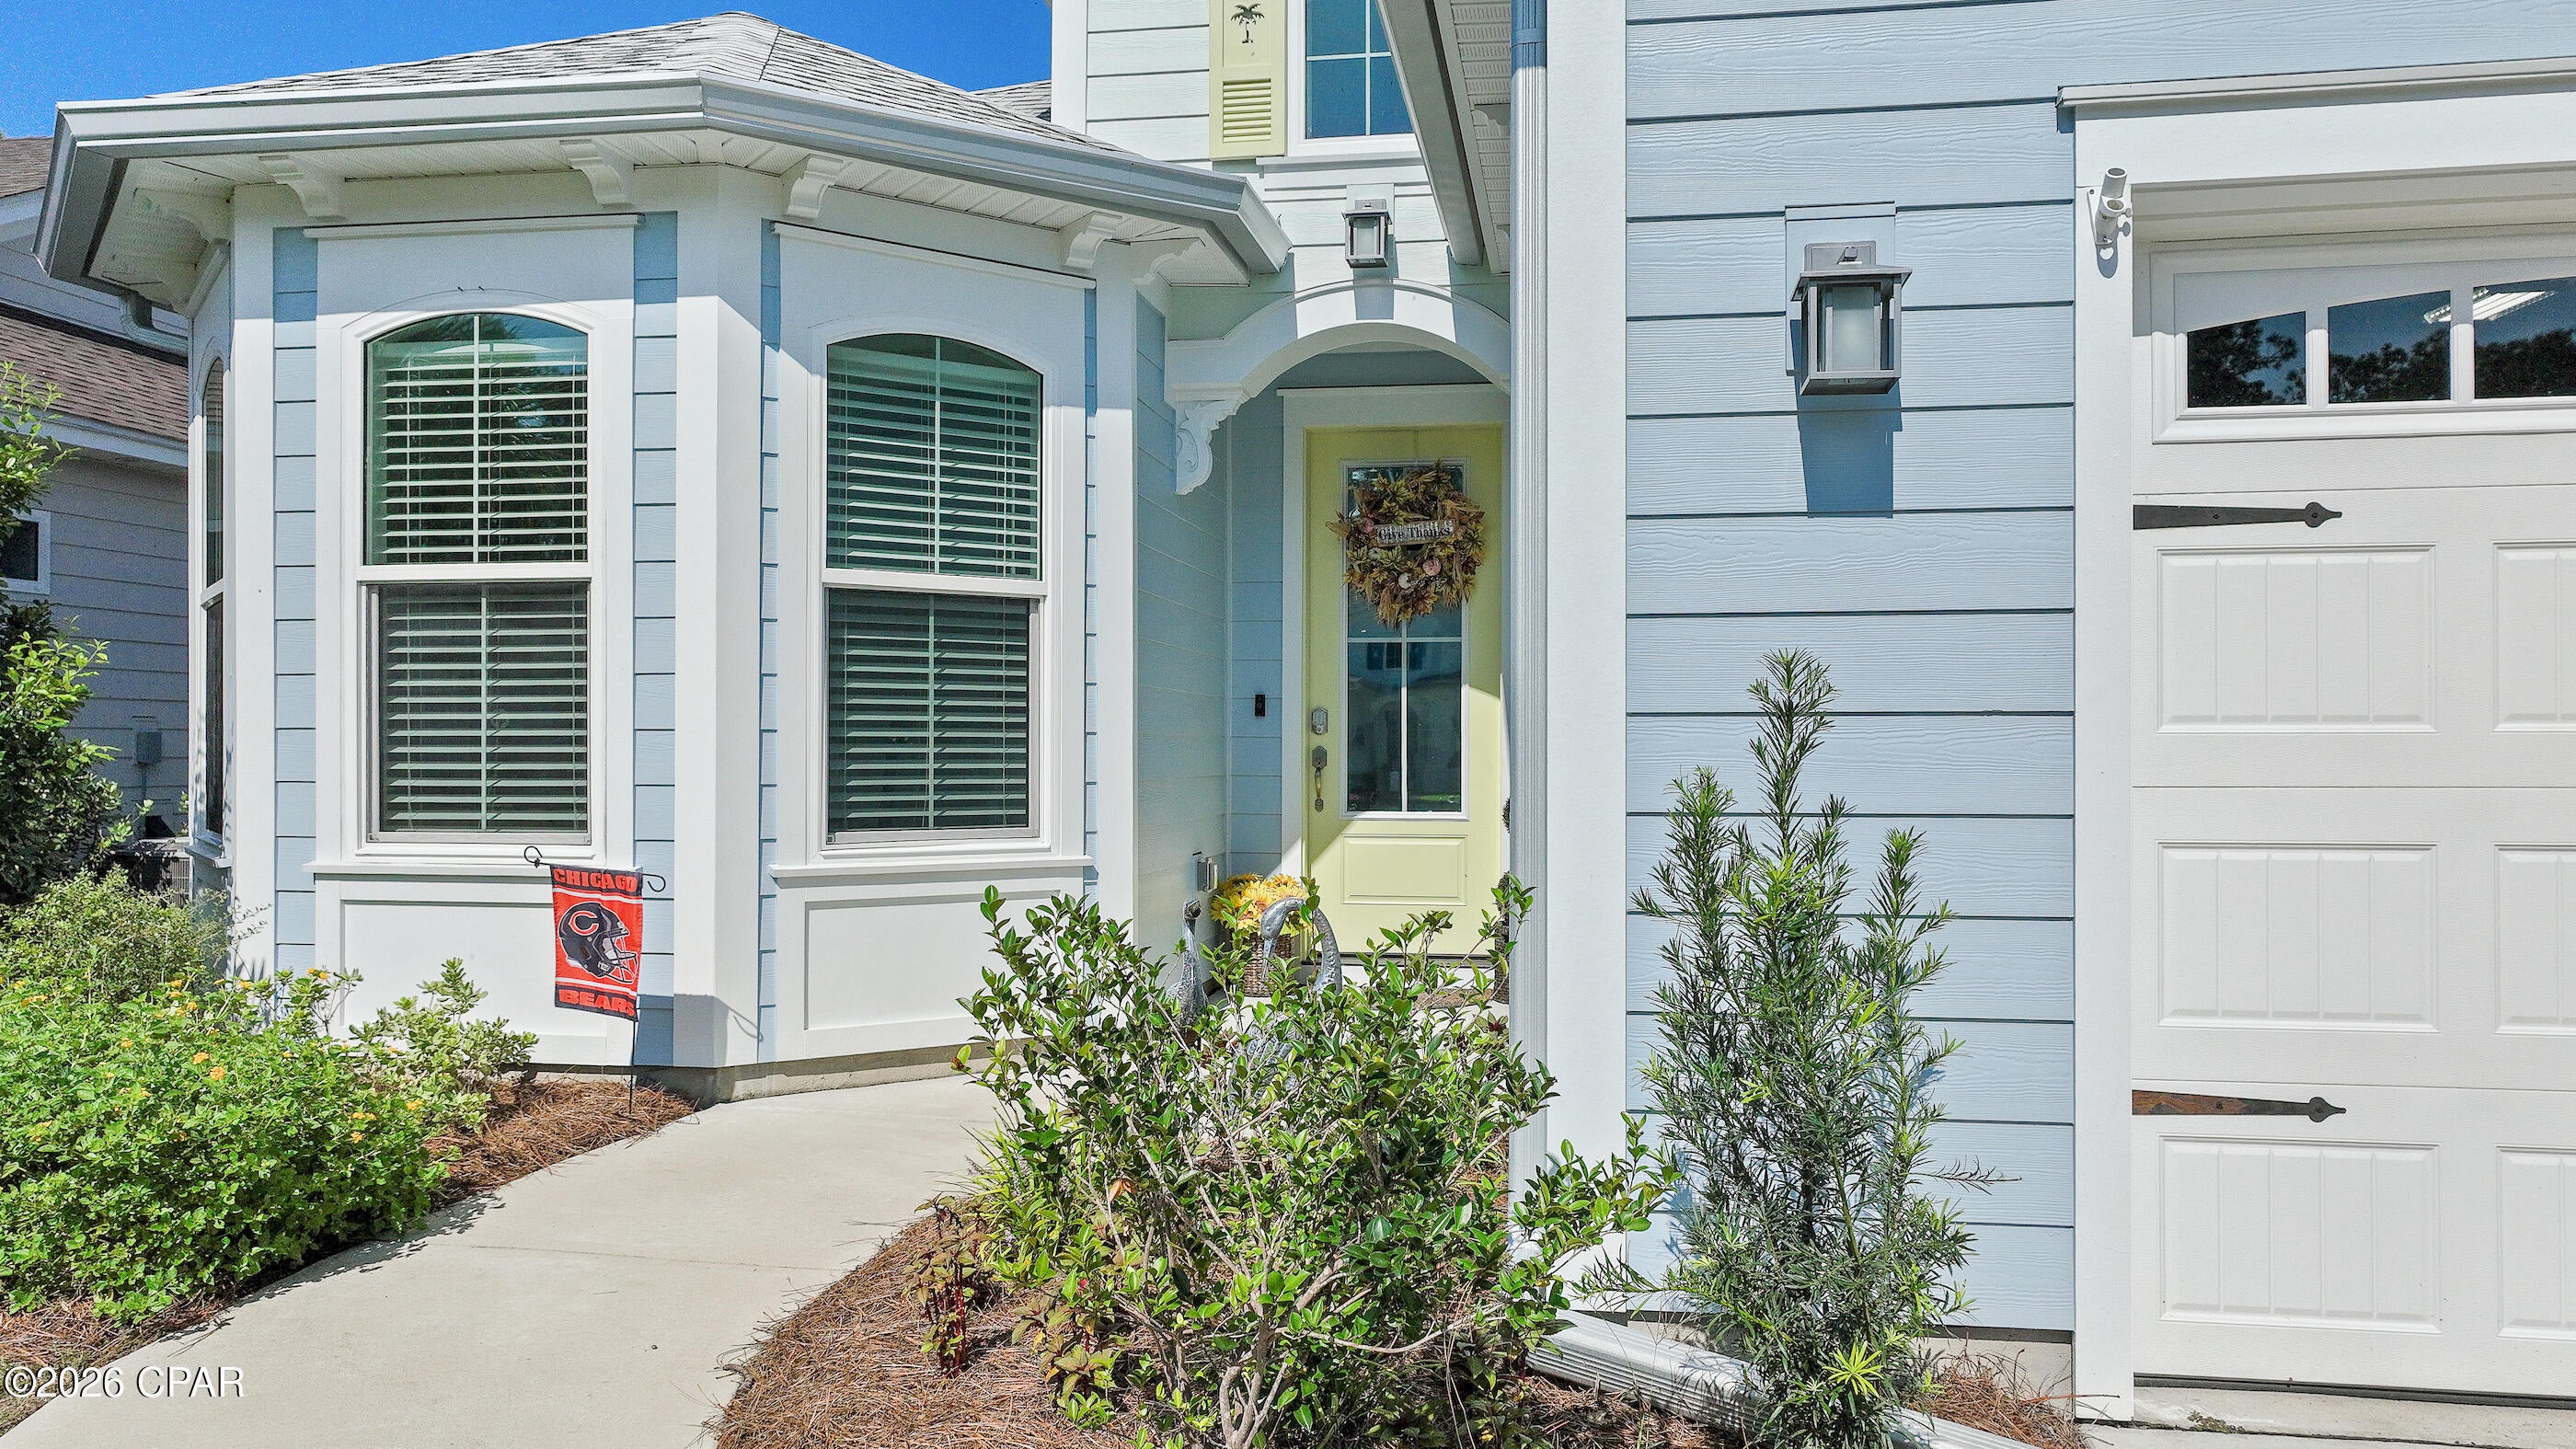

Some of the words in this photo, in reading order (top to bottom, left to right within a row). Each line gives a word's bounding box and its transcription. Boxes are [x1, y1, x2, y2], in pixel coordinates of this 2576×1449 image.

[1379, 527, 1405, 540] Give
[1408, 527, 1451, 538] Thanks
[553, 868, 638, 892] CHICAGO
[558, 989, 635, 1016] BEARS
